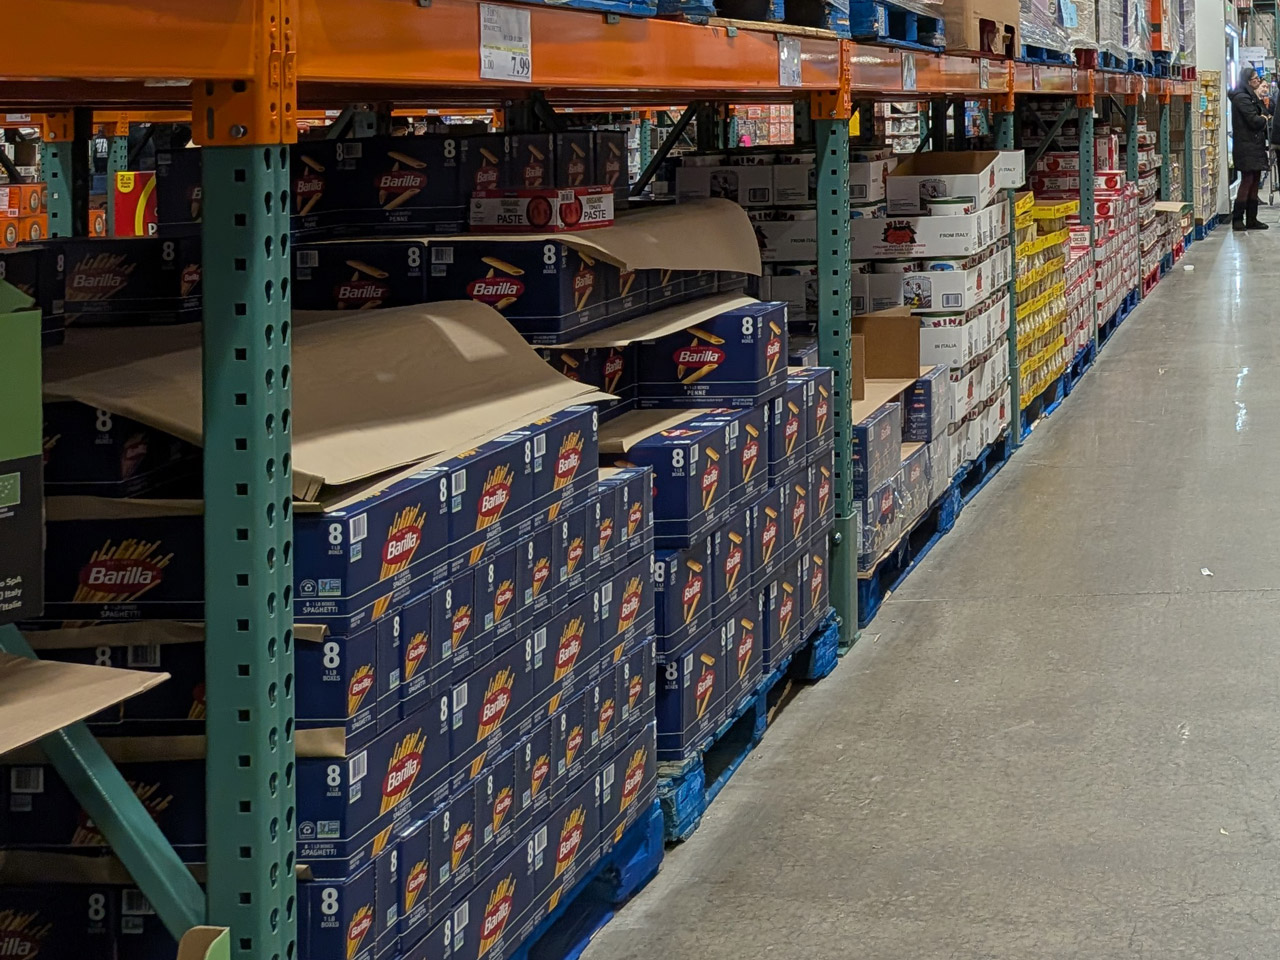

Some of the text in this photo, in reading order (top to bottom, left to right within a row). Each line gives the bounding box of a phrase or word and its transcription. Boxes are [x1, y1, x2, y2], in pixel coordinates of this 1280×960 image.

[511, 56, 530, 76] 7.99
[444, 139, 456, 158] 8
[380, 175, 421, 188] Barilla
[497, 215, 523, 224] PASTE
[583, 210, 607, 220] PASTE
[162, 242, 176, 261] 8
[408, 246, 420, 268] 8
[543, 244, 556, 265] 8
[73, 275, 121, 289] Barilla
[473, 283, 518, 296] Barilla
[338, 286, 383, 299] Barilla
[742, 316, 754, 335] 8
[931, 318, 963, 328] NINA
[679, 350, 721, 363] Barilla
[95, 408, 113, 432] 8
[672, 448, 685, 468] 8
[328, 523, 343, 545] 8
[89, 567, 152, 585] Barilla
[654, 561, 666, 583] 8
[100, 609, 141, 618] SPAGHETTI
[323, 641, 341, 669] 8
[665, 661, 678, 680] 8
[440, 696, 449, 721] 8
[327, 764, 341, 786] 8
[301, 848, 337, 856] SPAGHETTI
[321, 887, 339, 915] 8
